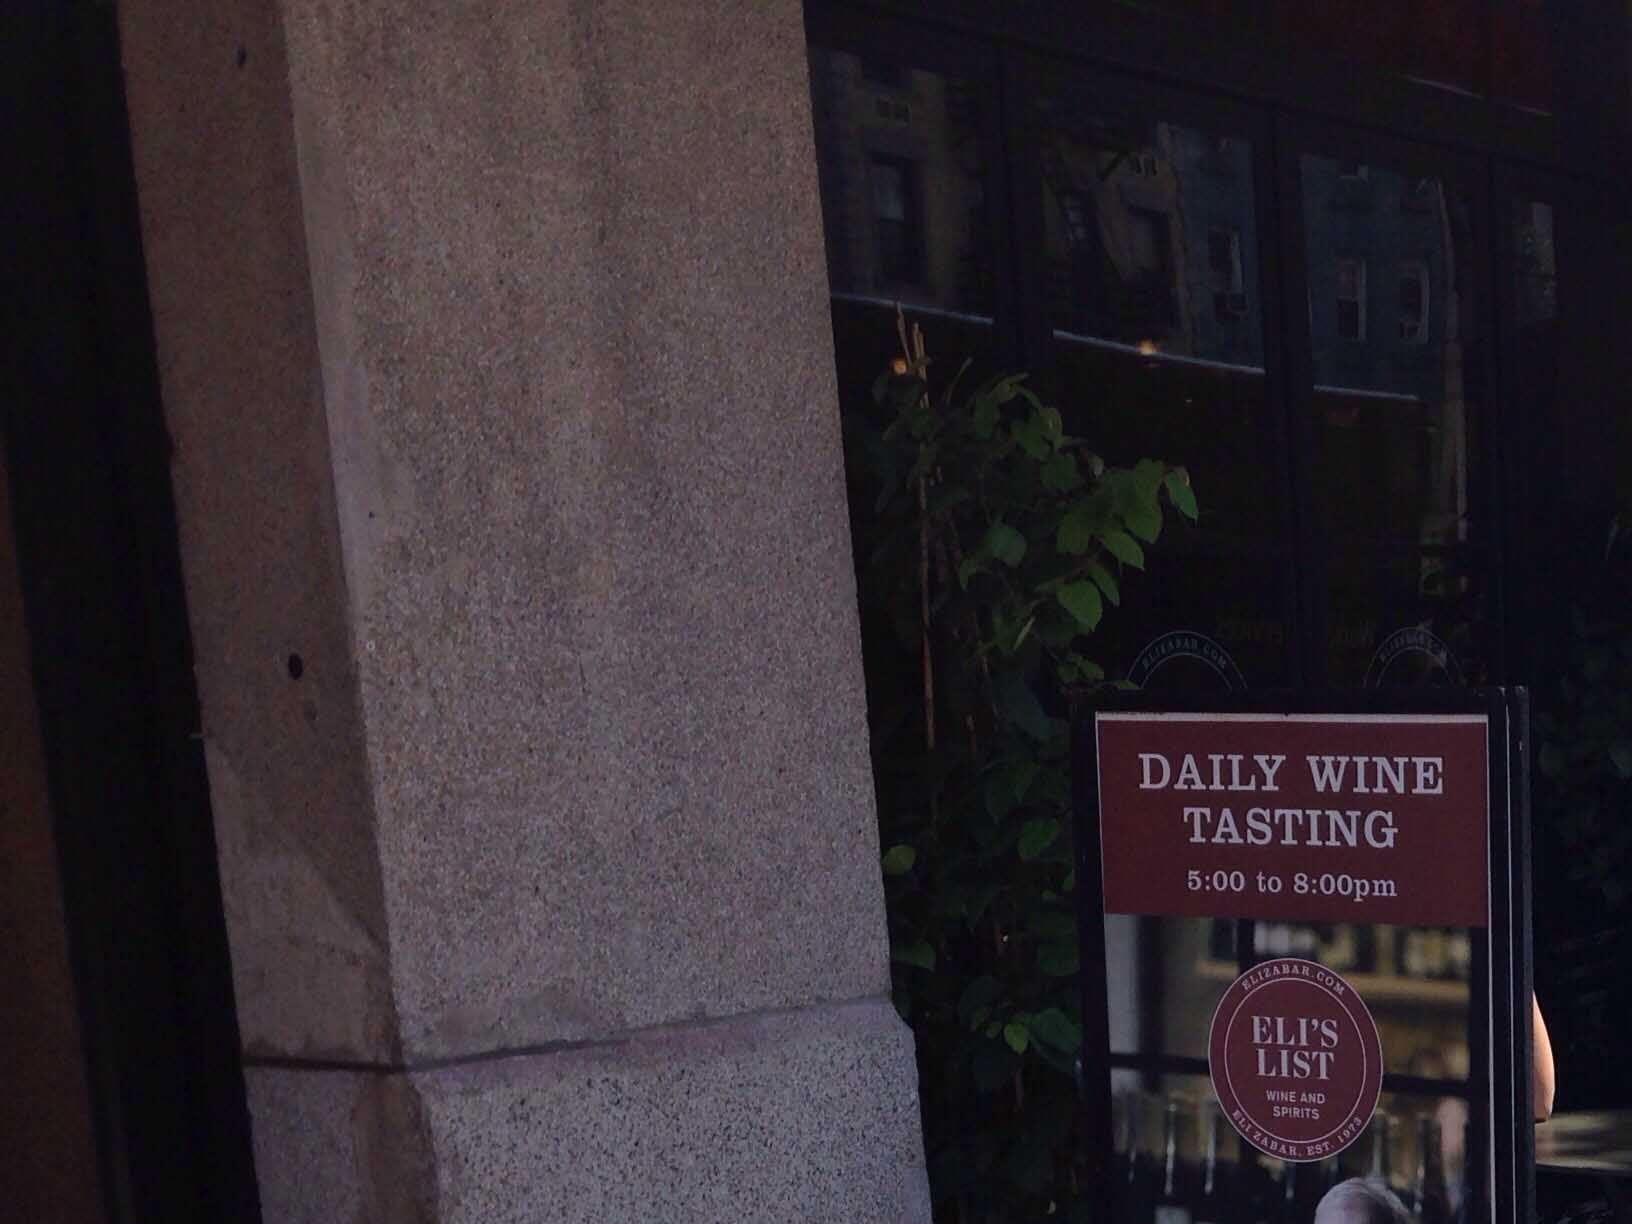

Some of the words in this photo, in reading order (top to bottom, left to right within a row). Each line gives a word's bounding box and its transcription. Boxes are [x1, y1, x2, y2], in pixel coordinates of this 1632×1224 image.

[1138, 753, 1286, 792] DAILY
[1306, 755, 1444, 795] WINE
[1183, 806, 1400, 848] TASTING
[1187, 869, 1246, 891] 5:00
[1256, 871, 1282, 893] to
[1293, 872, 1398, 902] 8:00pm
[1241, 964, 1345, 995] ELIZABAR.COM
[1251, 1015, 1339, 1048] ELI'S
[1255, 1047, 1335, 1080] LIST
[1266, 1090, 1297, 1104] WINE
[1300, 1091, 1326, 1105] AND
[1272, 1105, 1320, 1120] SPIRITS
[1232, 1109, 1251, 1132] ELI
[1337, 1116, 1363, 1144] 1973
